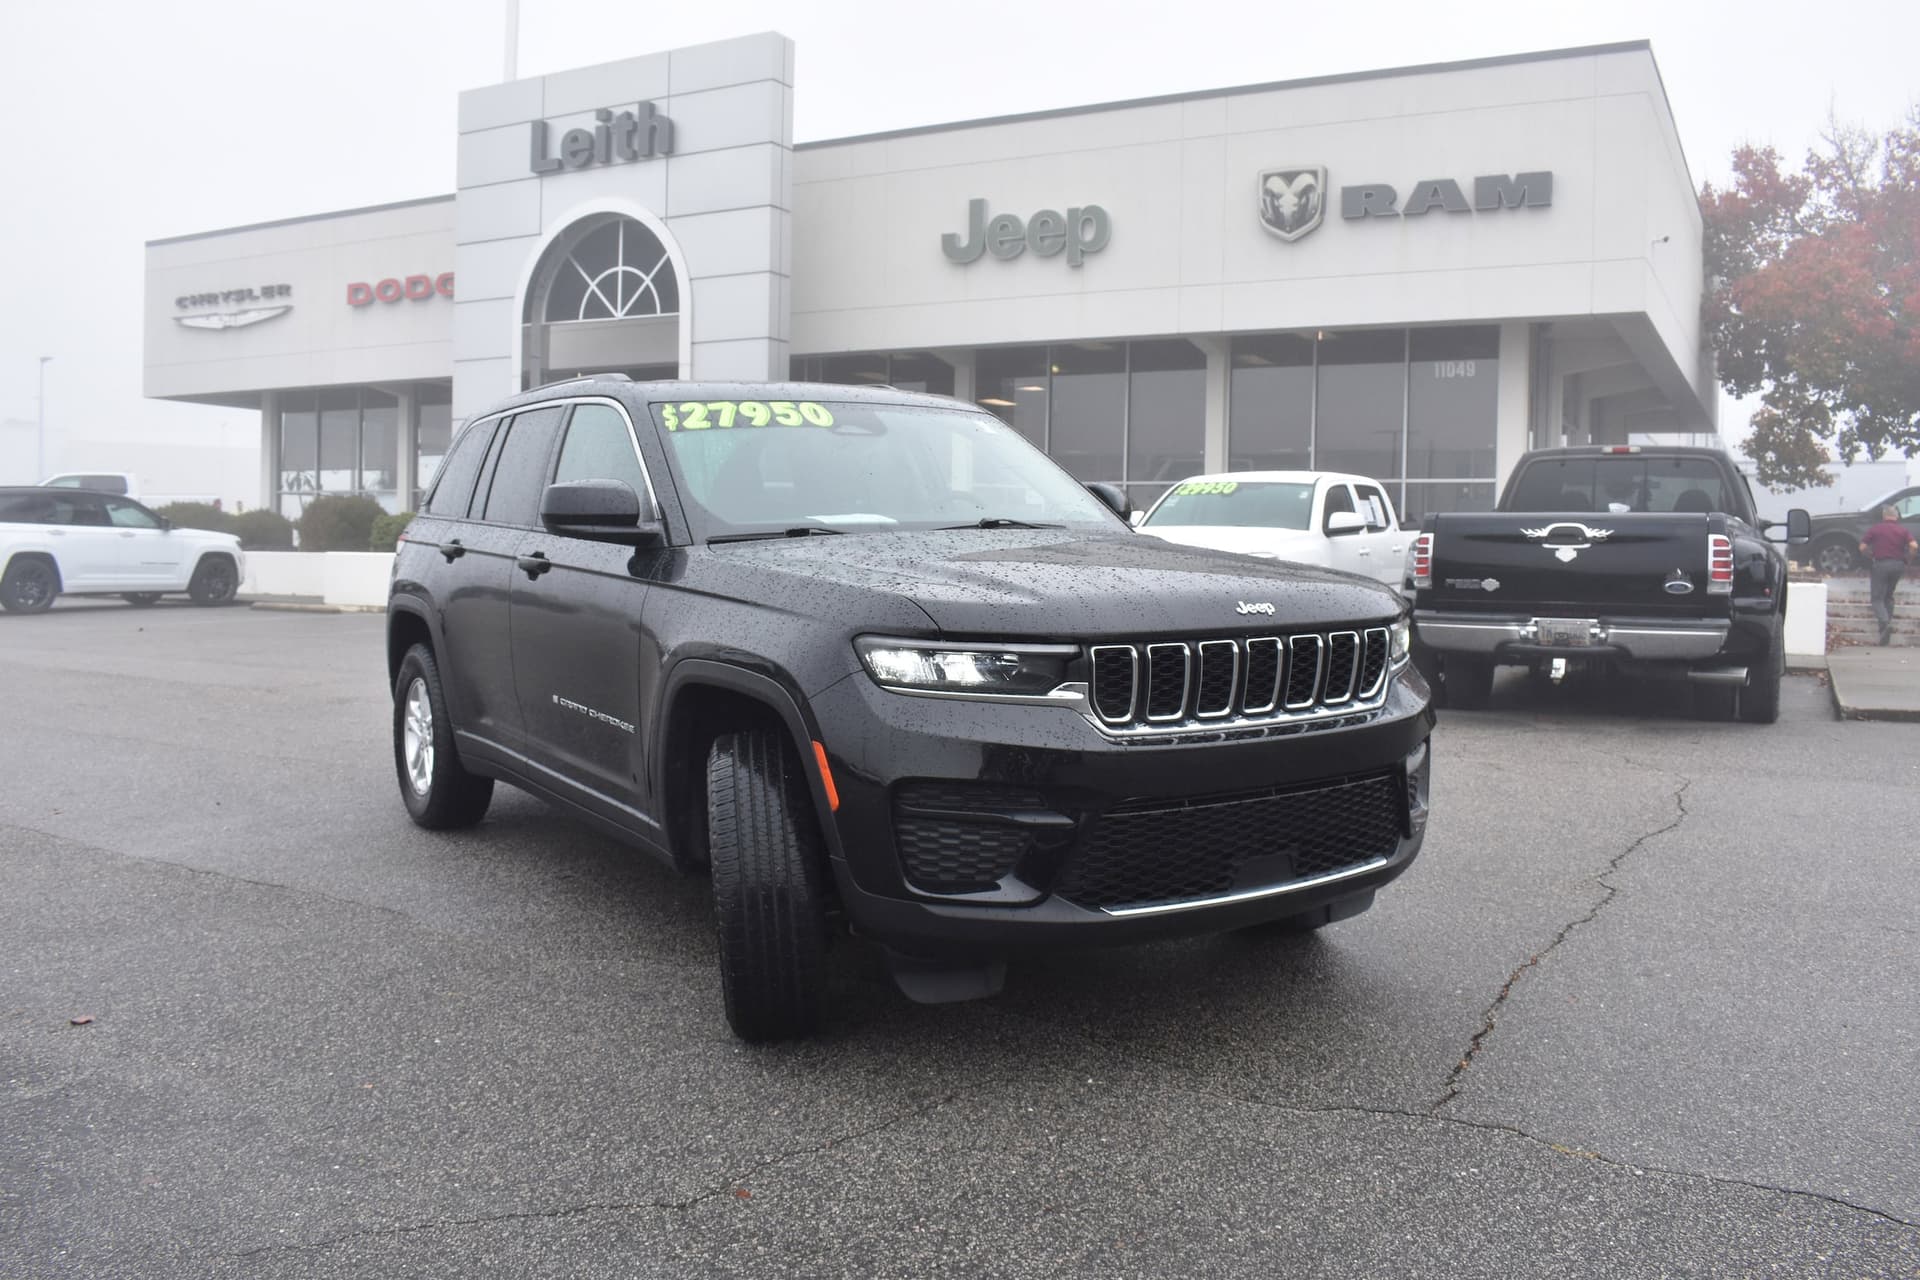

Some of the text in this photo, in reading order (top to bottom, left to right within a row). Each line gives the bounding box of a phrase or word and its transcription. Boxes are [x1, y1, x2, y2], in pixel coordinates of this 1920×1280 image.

[530, 100, 675, 175] Leith
[1341, 171, 1553, 219] RAM
[941, 198, 1112, 267] Jeep
[175, 284, 291, 309] CHRYSLER
[1434, 360, 1476, 379] 11049
[662, 401, 834, 432] $27950
[1236, 601, 1276, 616] Jeep
